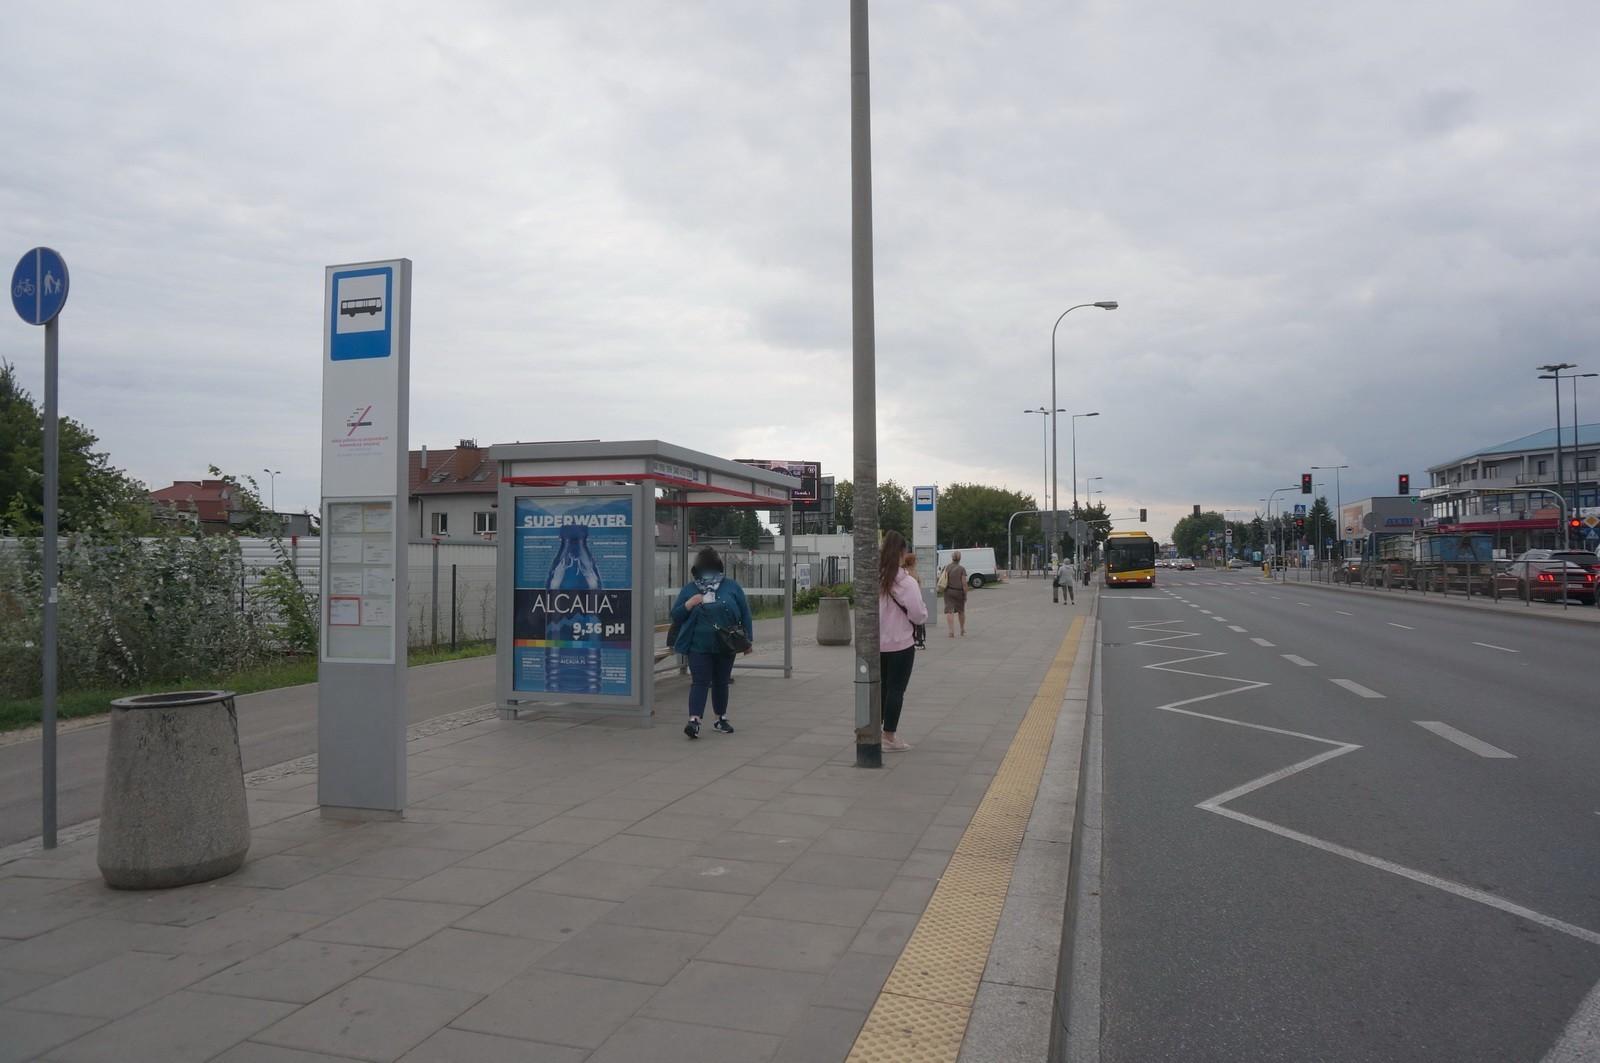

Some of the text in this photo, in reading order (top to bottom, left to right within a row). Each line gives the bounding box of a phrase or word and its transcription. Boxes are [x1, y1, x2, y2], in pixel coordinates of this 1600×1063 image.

[524, 514, 626, 527] SUPERWATER
[531, 593, 614, 614] ALCALIA
[572, 622, 625, 637] 9,36 pH
